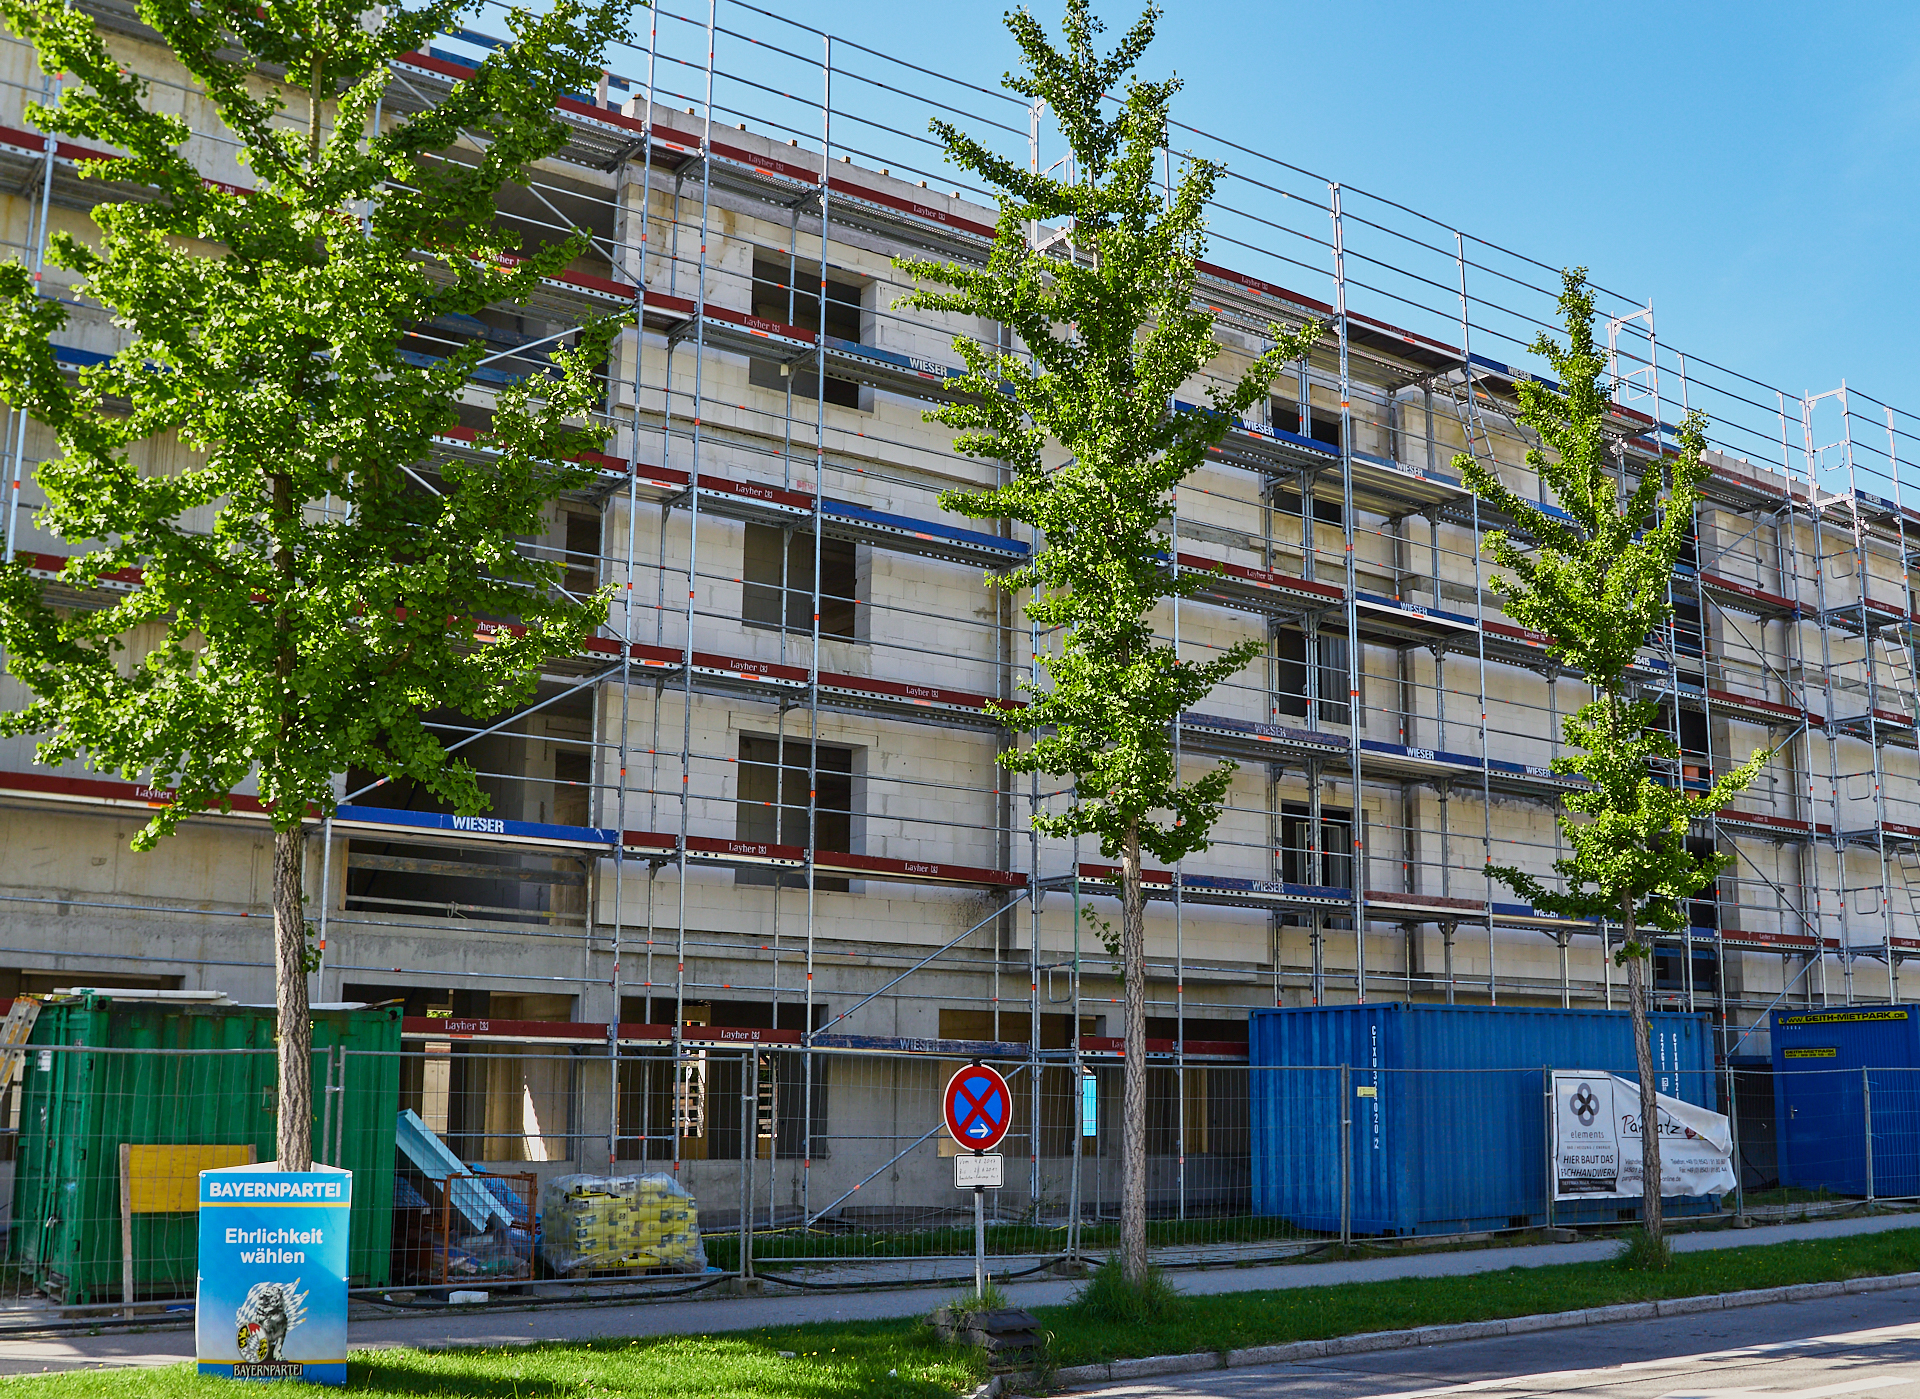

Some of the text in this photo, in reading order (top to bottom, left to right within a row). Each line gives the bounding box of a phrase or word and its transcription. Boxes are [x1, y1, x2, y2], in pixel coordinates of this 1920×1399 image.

[748, 153, 776, 168] Layher
[913, 204, 937, 219] Layher
[743, 316, 770, 330] Layher
[909, 357, 948, 377] WIESER
[1507, 365, 1532, 381] WIESER
[1242, 419, 1275, 437] WIESER
[1395, 461, 1423, 477] WIESER
[735, 483, 762, 497] Layher
[1399, 601, 1428, 616] WIESER
[730, 660, 757, 673] Layher
[906, 686, 930, 698] Layher
[1254, 723, 1286, 738] WIESER
[1406, 746, 1434, 760] WIESER
[1525, 765, 1551, 778] WIESER
[135, 787, 172, 800] Layher
[452, 815, 504, 834] WIESER
[729, 842, 756, 854] Layher
[904, 862, 929, 874] Layher
[1252, 880, 1284, 893] WIESER
[445, 1020, 477, 1031] Layher
[720, 1030, 749, 1041] Layher
[1570, 1130, 1604, 1139] elements
[1563, 1155, 1580, 1164] HIER
[1581, 1155, 1599, 1164] BAUT
[1600, 1155, 1614, 1163] DAS
[209, 1182, 341, 1198] BAYERNPARTEI
[225, 1228, 323, 1244] Ehrlichkeit
[240, 1248, 305, 1264] wählen
[234, 1364, 302, 1377] BAYERNPARTEI
